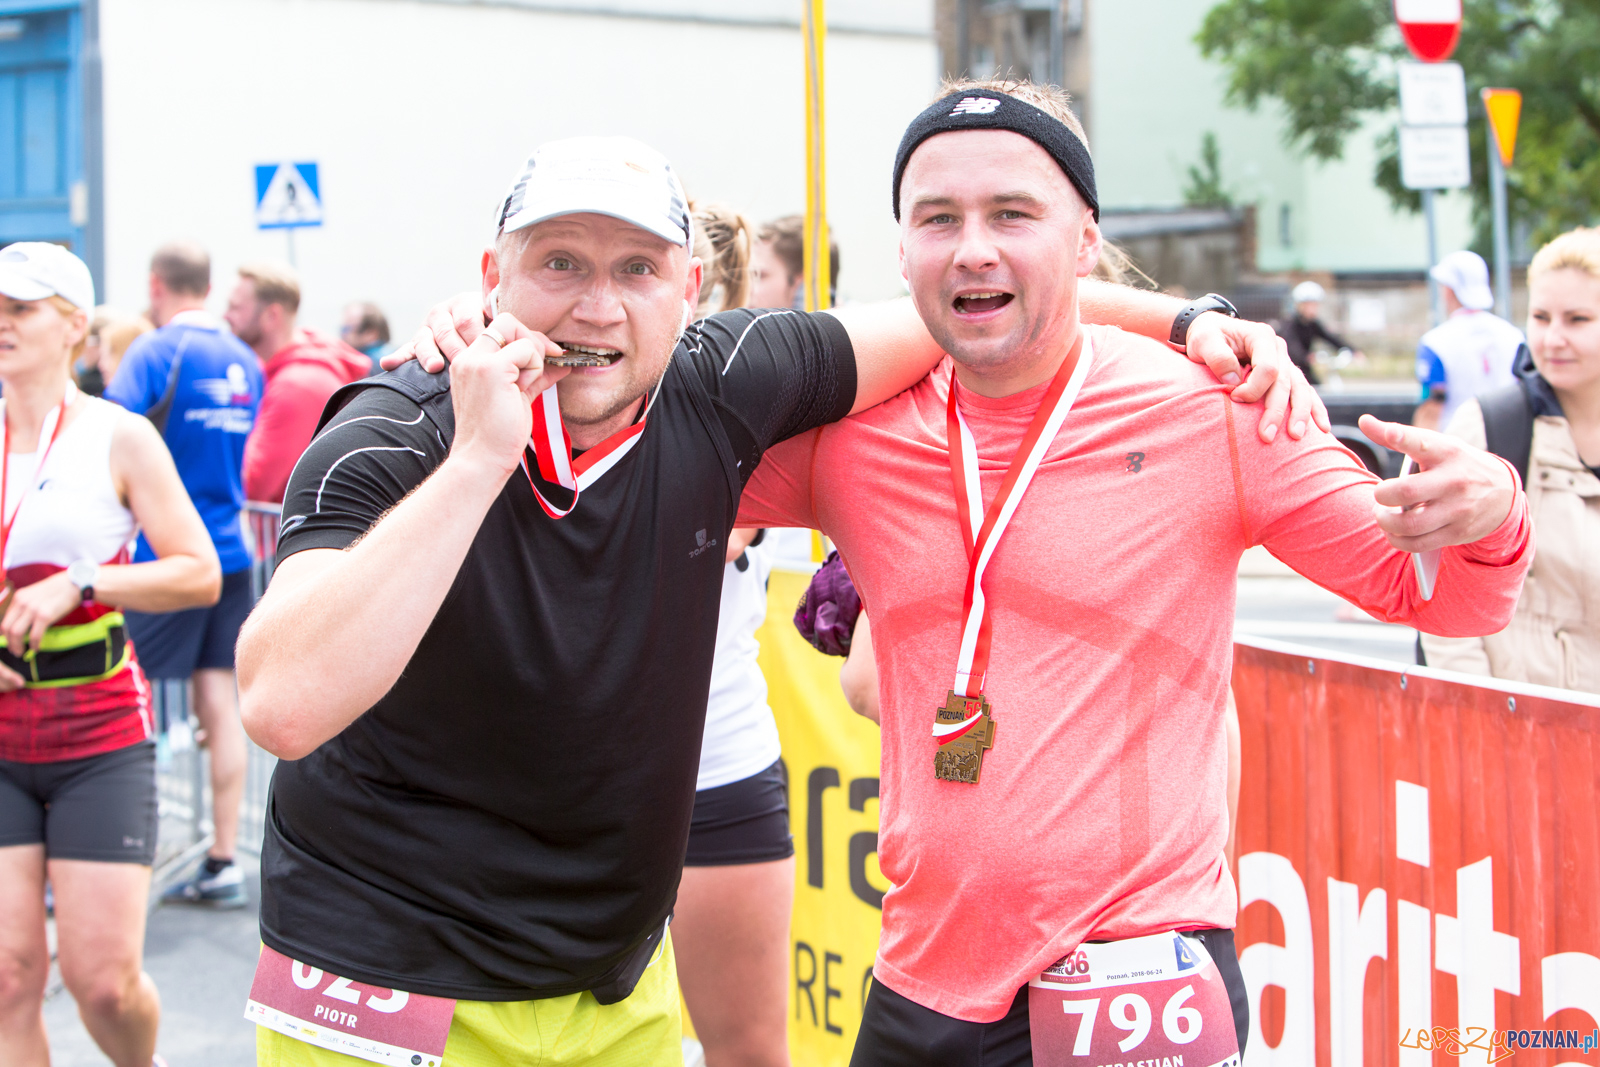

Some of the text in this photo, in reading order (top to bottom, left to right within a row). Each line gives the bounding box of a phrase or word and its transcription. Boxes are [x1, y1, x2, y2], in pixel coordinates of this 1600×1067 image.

[938, 709, 965, 721] POZNAŃ
[1131, 968, 1163, 978] 2018-06-24
[313, 1004, 358, 1029] PIOTR
[1062, 984, 1204, 1056] 796
